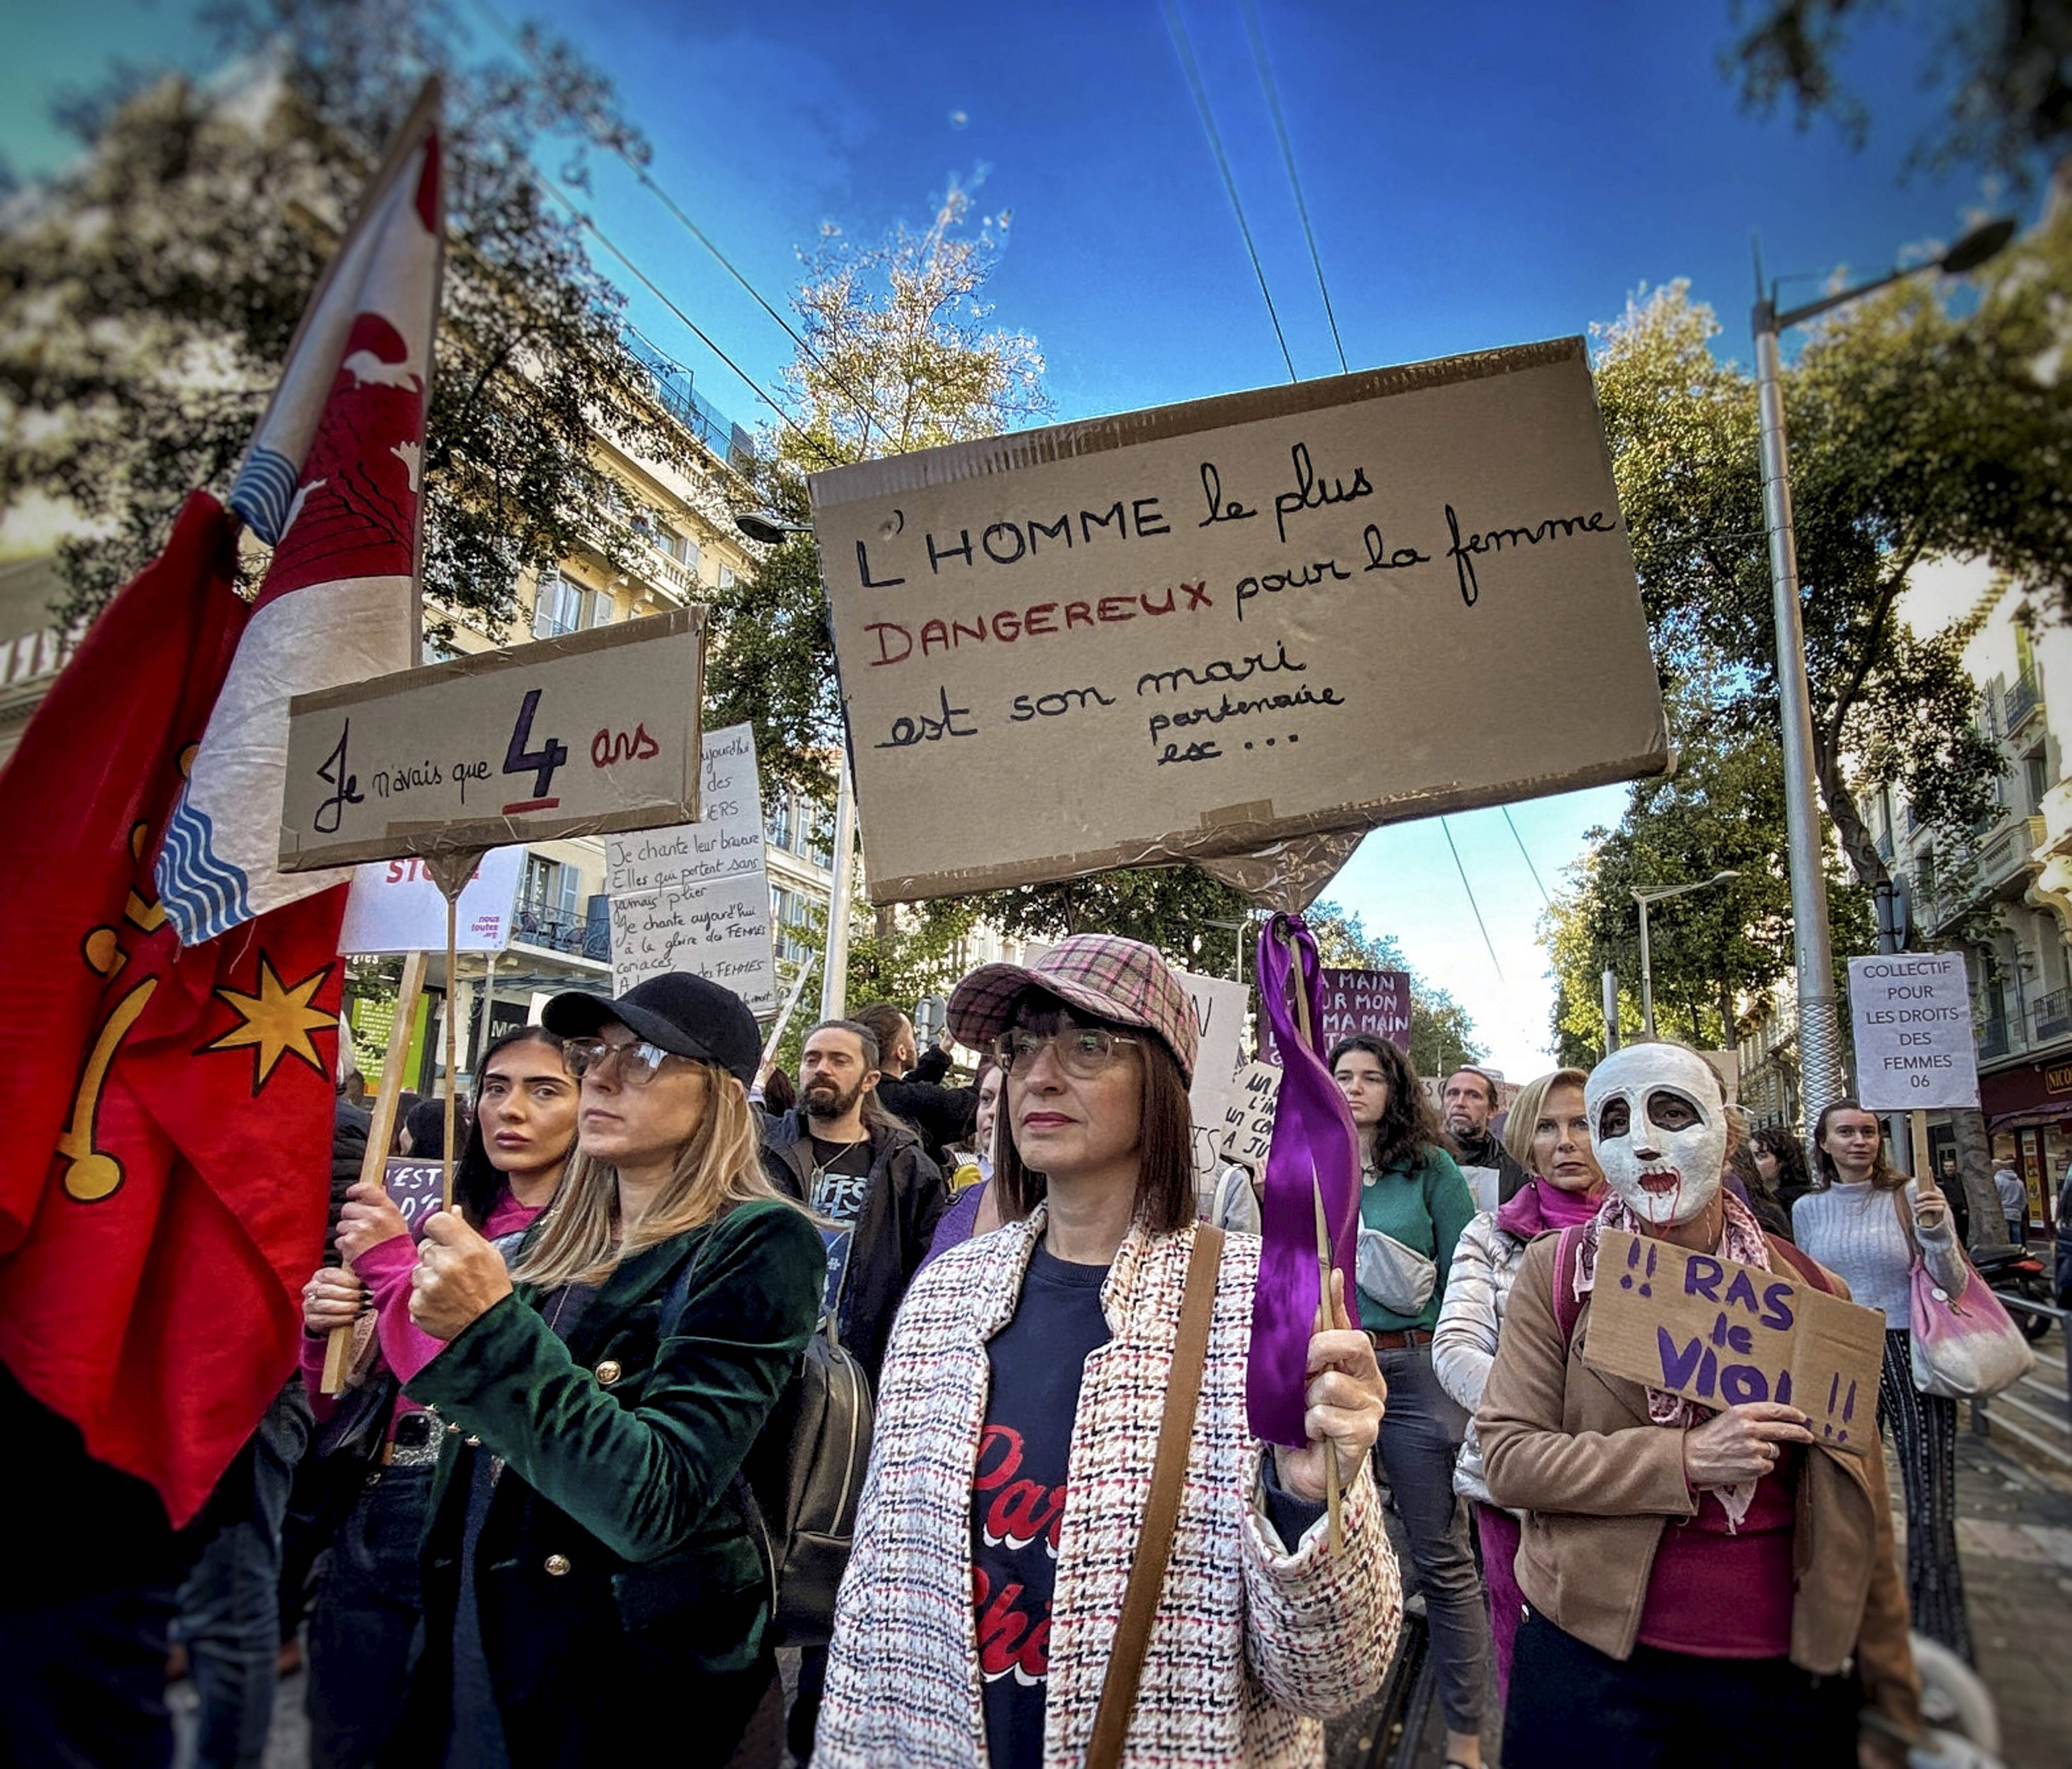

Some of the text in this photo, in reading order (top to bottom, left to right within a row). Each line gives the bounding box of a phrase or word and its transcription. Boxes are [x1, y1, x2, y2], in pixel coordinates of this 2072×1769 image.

[1199, 462, 1256, 527] le
[1275, 442, 1373, 543] plus
[864, 504, 1616, 666] DANGEREUX pour la femme
[874, 640, 1306, 748] est son mari
[1149, 684, 1345, 745] partenaire
[314, 717, 364, 833] Je
[452, 761, 492, 805] que
[503, 689, 567, 797] 4
[591, 722, 659, 768] ans
[707, 772, 733, 792] des
[610, 841, 632, 867] Je
[638, 836, 689, 861] chante
[694, 834, 717, 852] leur
[612, 858, 759, 899] Elles qui portent sans
[667, 885, 707, 911] plier
[616, 902, 756, 948] Je chante aujourd'hui
[641, 937, 655, 953] la
[665, 931, 698, 960] gloire
[726, 923, 766, 938] FEMMES
[715, 960, 765, 978] FEMMES
[1864, 961, 1951, 978] COLLECTIF
[1355, 994, 1397, 1011] MON
[1888, 985, 1934, 1000] POUR
[1866, 1007, 1959, 1025] LES DROITS
[1899, 1032, 1932, 1046] DES
[1884, 1055, 1952, 1070] FEMMES
[1910, 1074, 1930, 1088] 06
[1223, 1131, 1237, 1149] A
[1684, 1255, 1795, 1332] RAS
[1708, 1311, 1753, 1355] le
